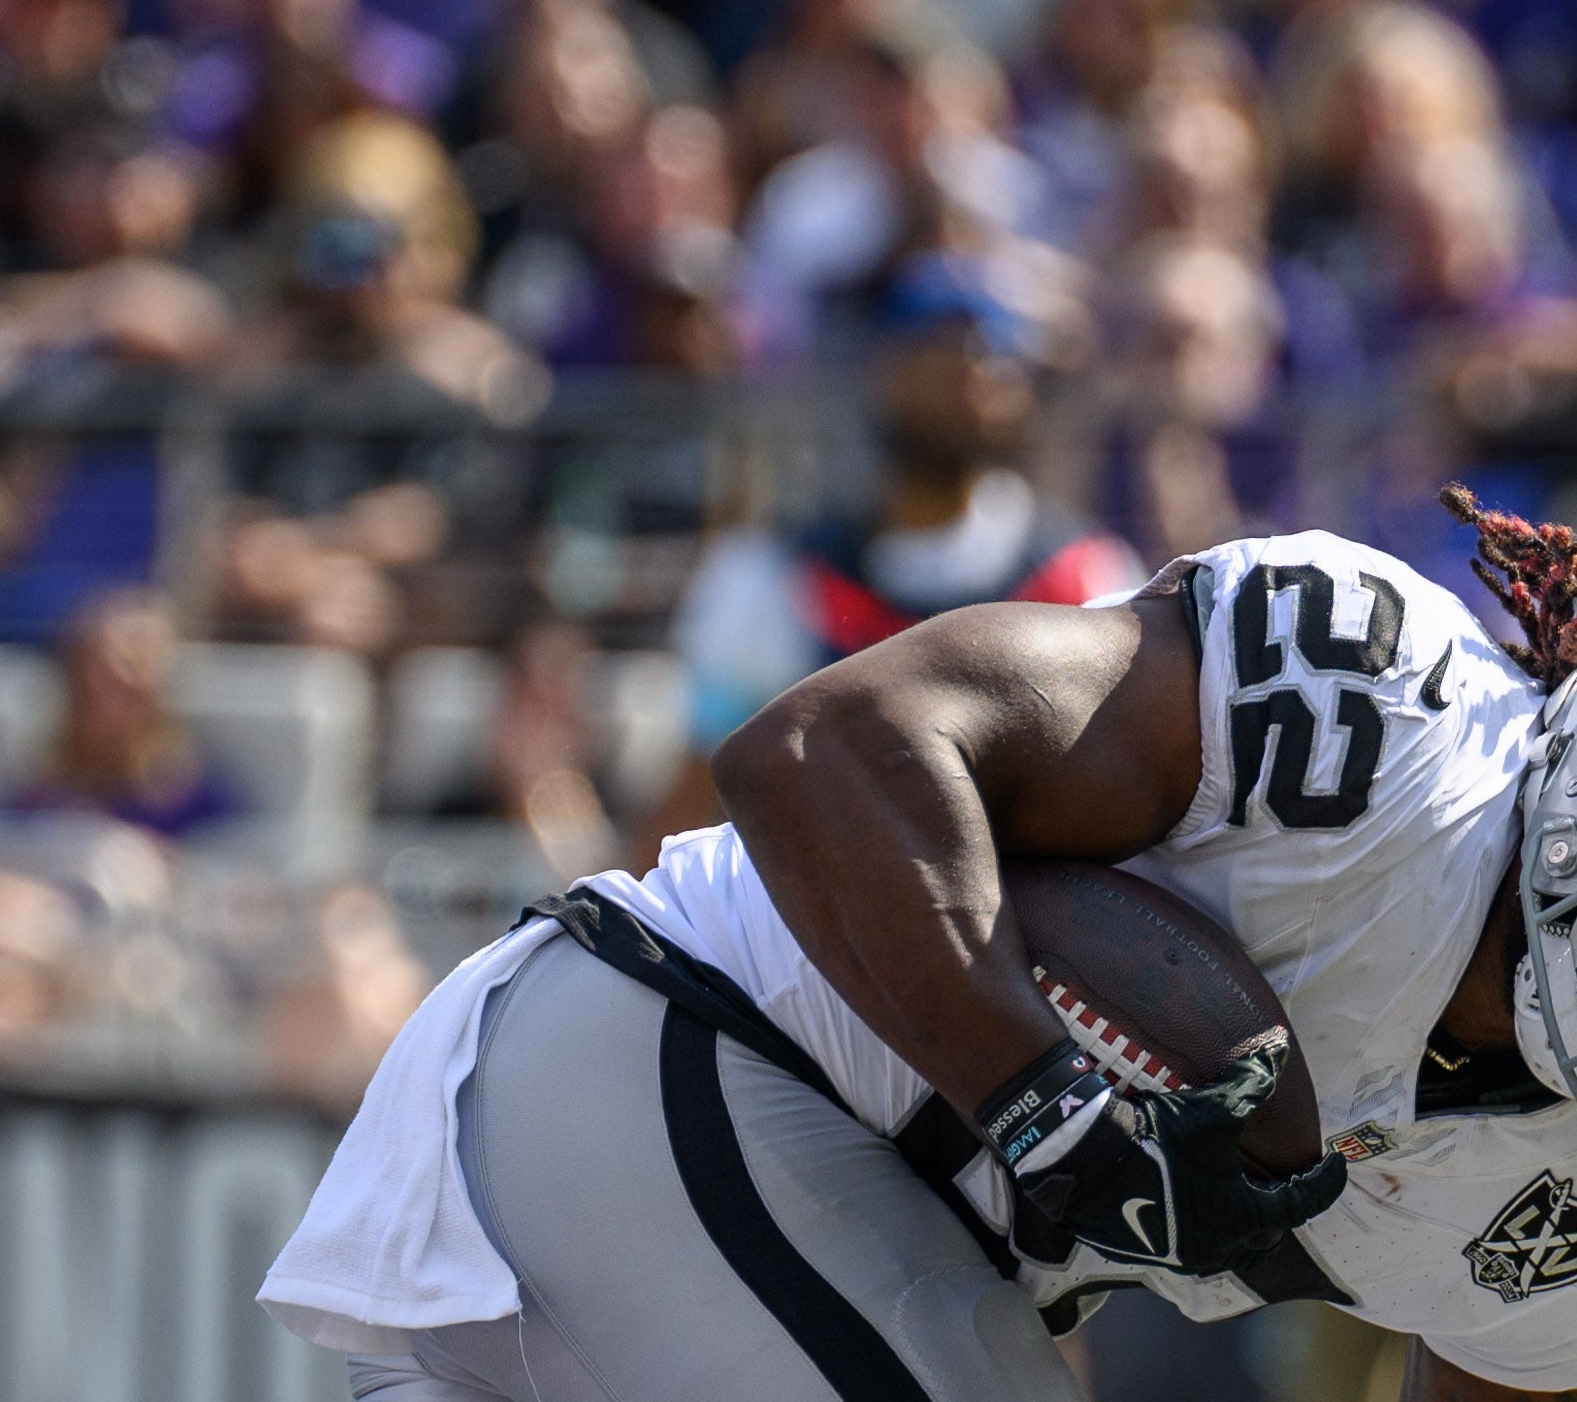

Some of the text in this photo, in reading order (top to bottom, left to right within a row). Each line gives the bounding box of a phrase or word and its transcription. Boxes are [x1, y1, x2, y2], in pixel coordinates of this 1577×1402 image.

[1226, 564, 1406, 830] 22
[1133, 900, 1219, 972] FOOTBALL
[988, 1089, 1041, 1144] Blessed
[1334, 1135, 1368, 1161] NFL
